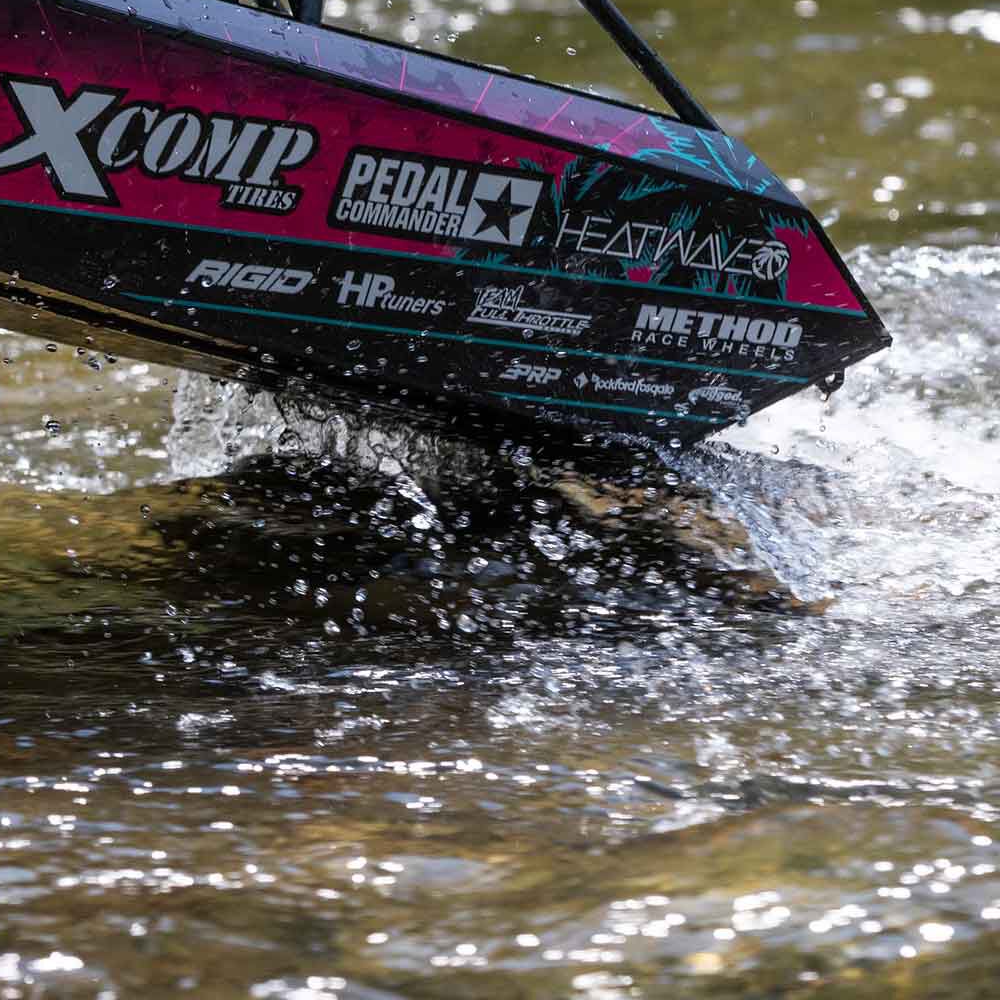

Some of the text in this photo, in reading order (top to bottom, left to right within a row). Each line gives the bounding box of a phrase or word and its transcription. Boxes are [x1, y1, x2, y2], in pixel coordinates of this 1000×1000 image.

[225, 184, 297, 210] TIRES
[342, 153, 467, 215] PEDAL
[336, 199, 462, 237] COMMANDER
[555, 213, 763, 275] HEATWAVE
[185, 259, 313, 294] RIGID
[474, 285, 524, 312] TEAM
[471, 307, 510, 320] FULL
[513, 309, 592, 331] THROTTLE
[635, 304, 803, 347] METHOD
[632, 330, 796, 361] RACE WHEELS
